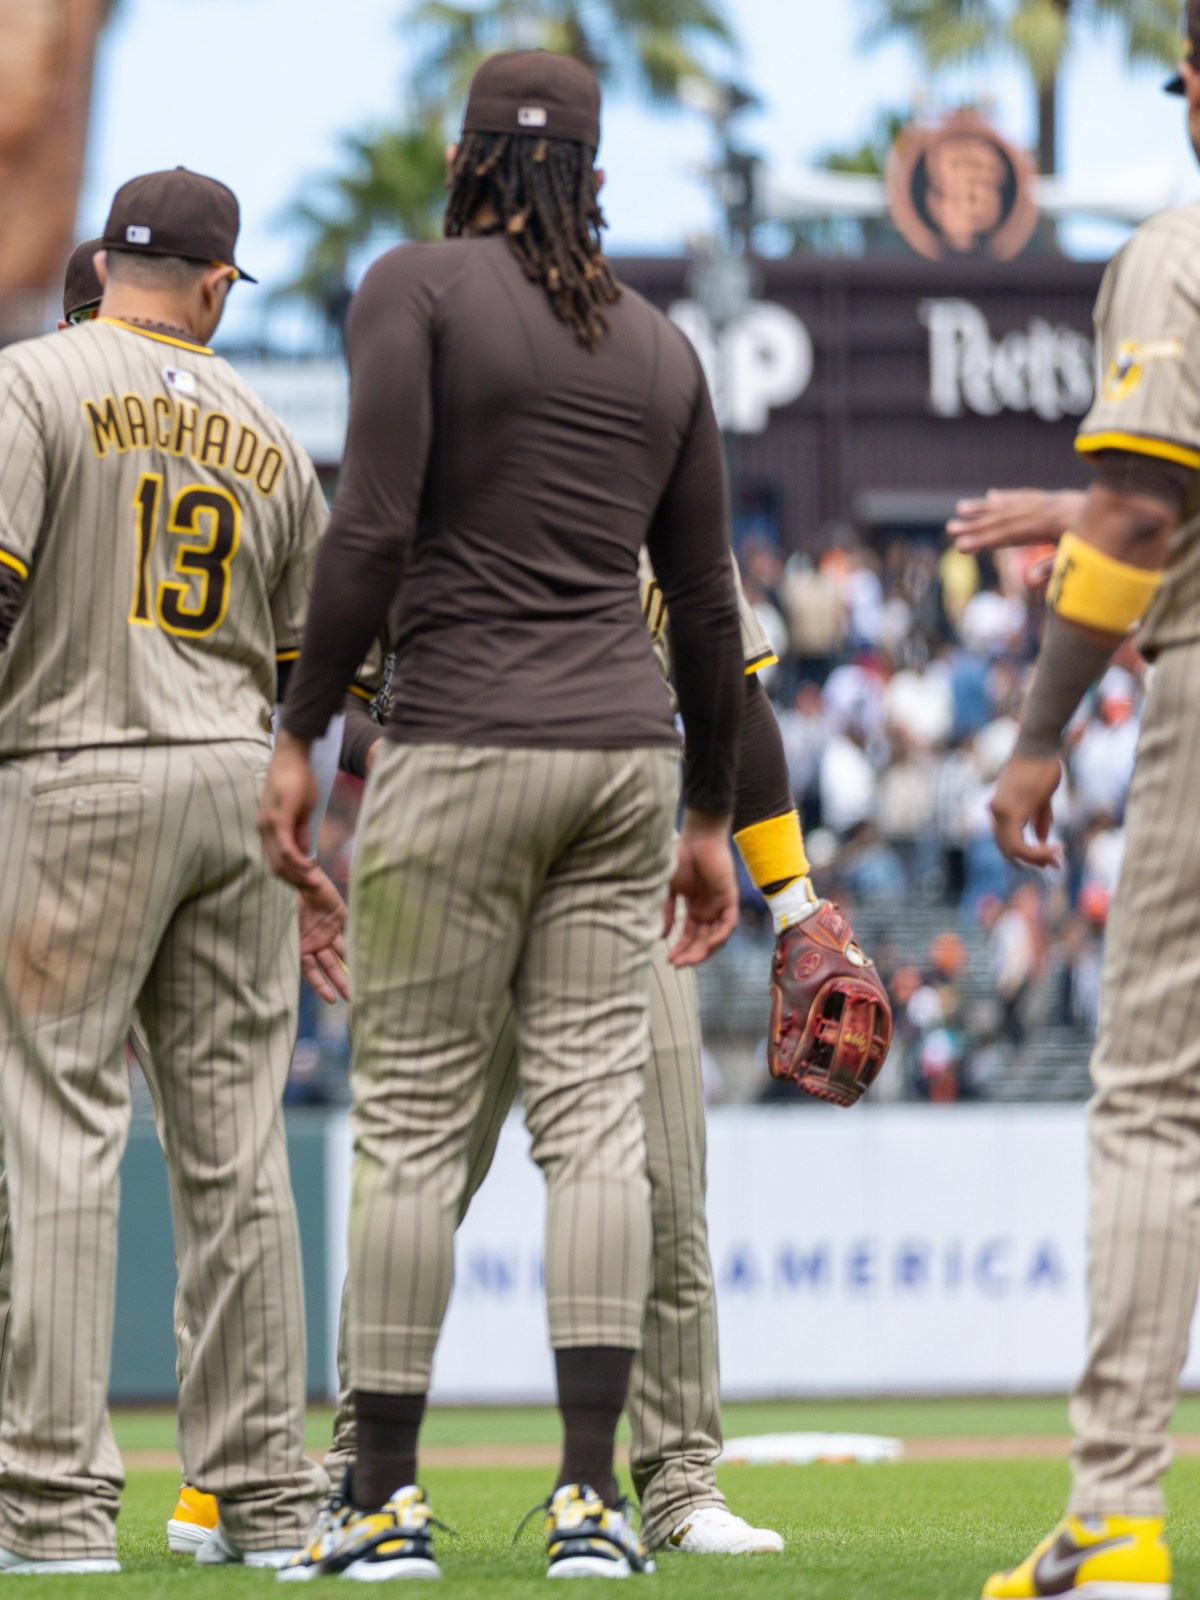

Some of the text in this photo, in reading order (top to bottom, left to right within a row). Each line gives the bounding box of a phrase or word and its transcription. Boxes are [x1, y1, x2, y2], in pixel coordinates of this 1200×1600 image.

[84, 395, 285, 496] MACHADO
[128, 472, 242, 639] 13
[717, 1237, 1068, 1299] AMERICA
